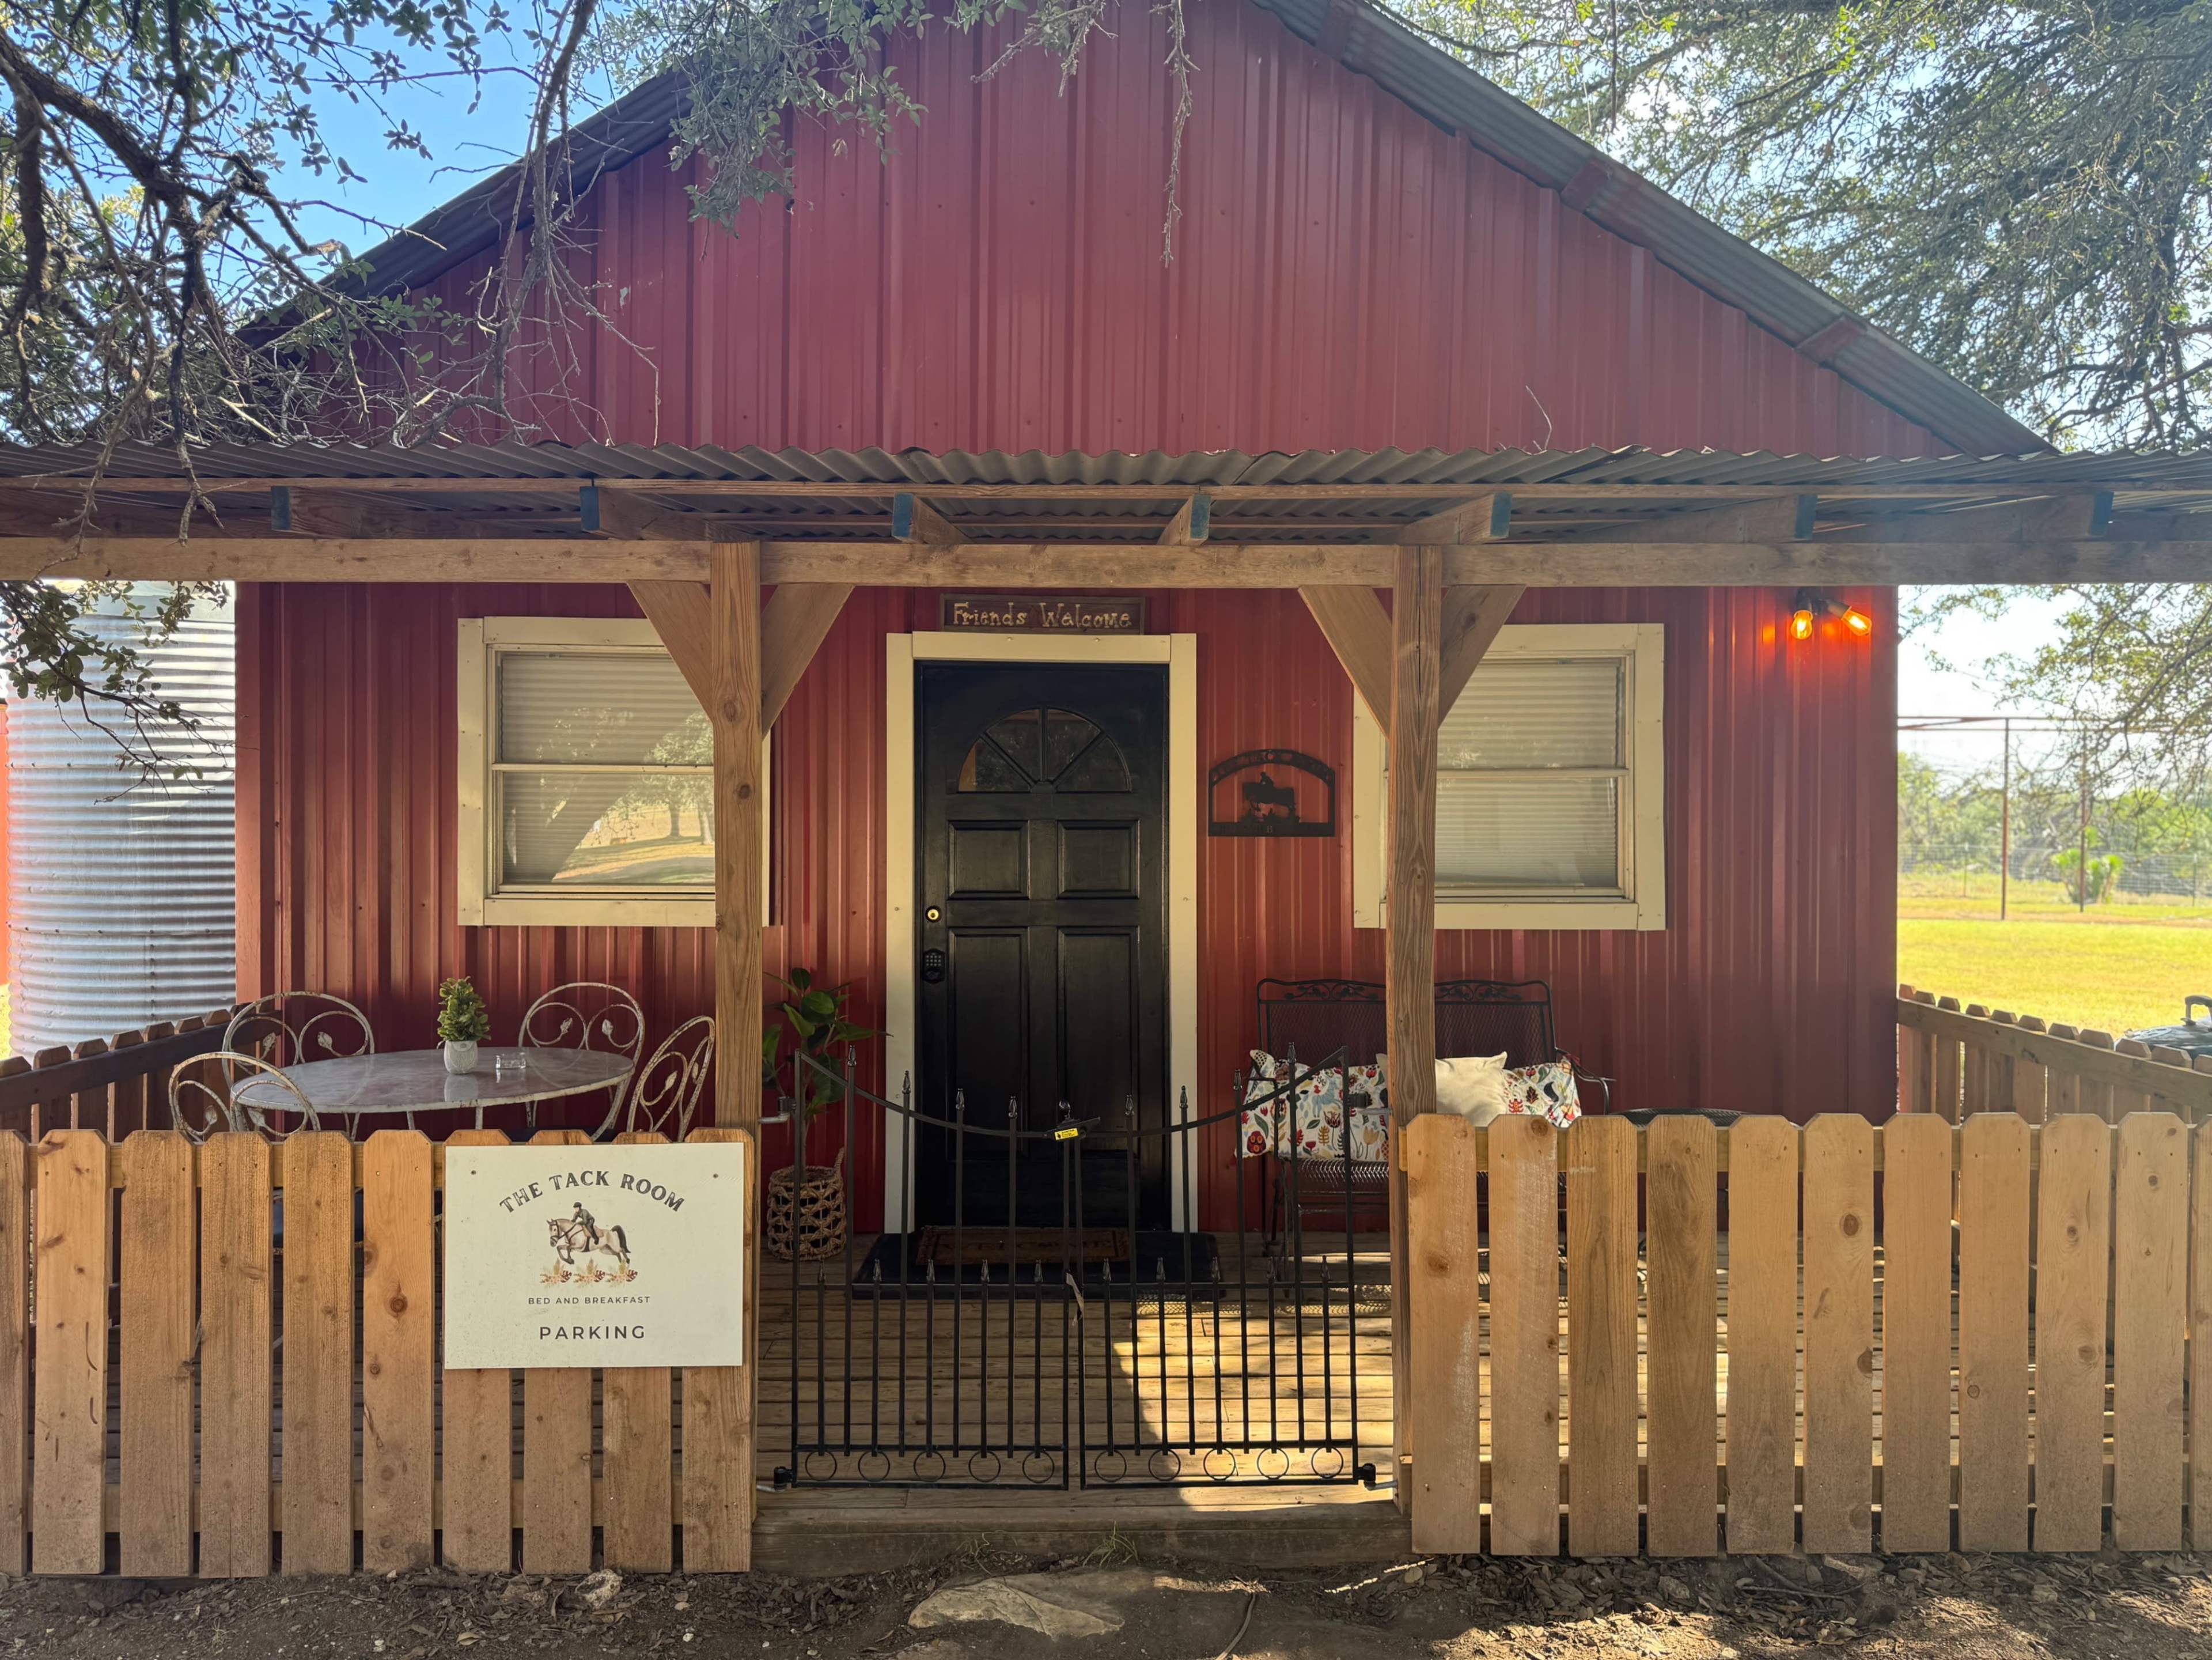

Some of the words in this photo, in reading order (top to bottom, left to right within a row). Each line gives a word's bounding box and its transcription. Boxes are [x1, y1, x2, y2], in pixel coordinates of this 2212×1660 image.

[953, 602, 1028, 626] Friends
[1039, 602, 1132, 629] Welcome
[499, 1182, 543, 1213] THE
[548, 1170, 609, 1190] TACK
[620, 1173, 685, 1212] ROOM
[539, 1325, 645, 1340] PARKING
